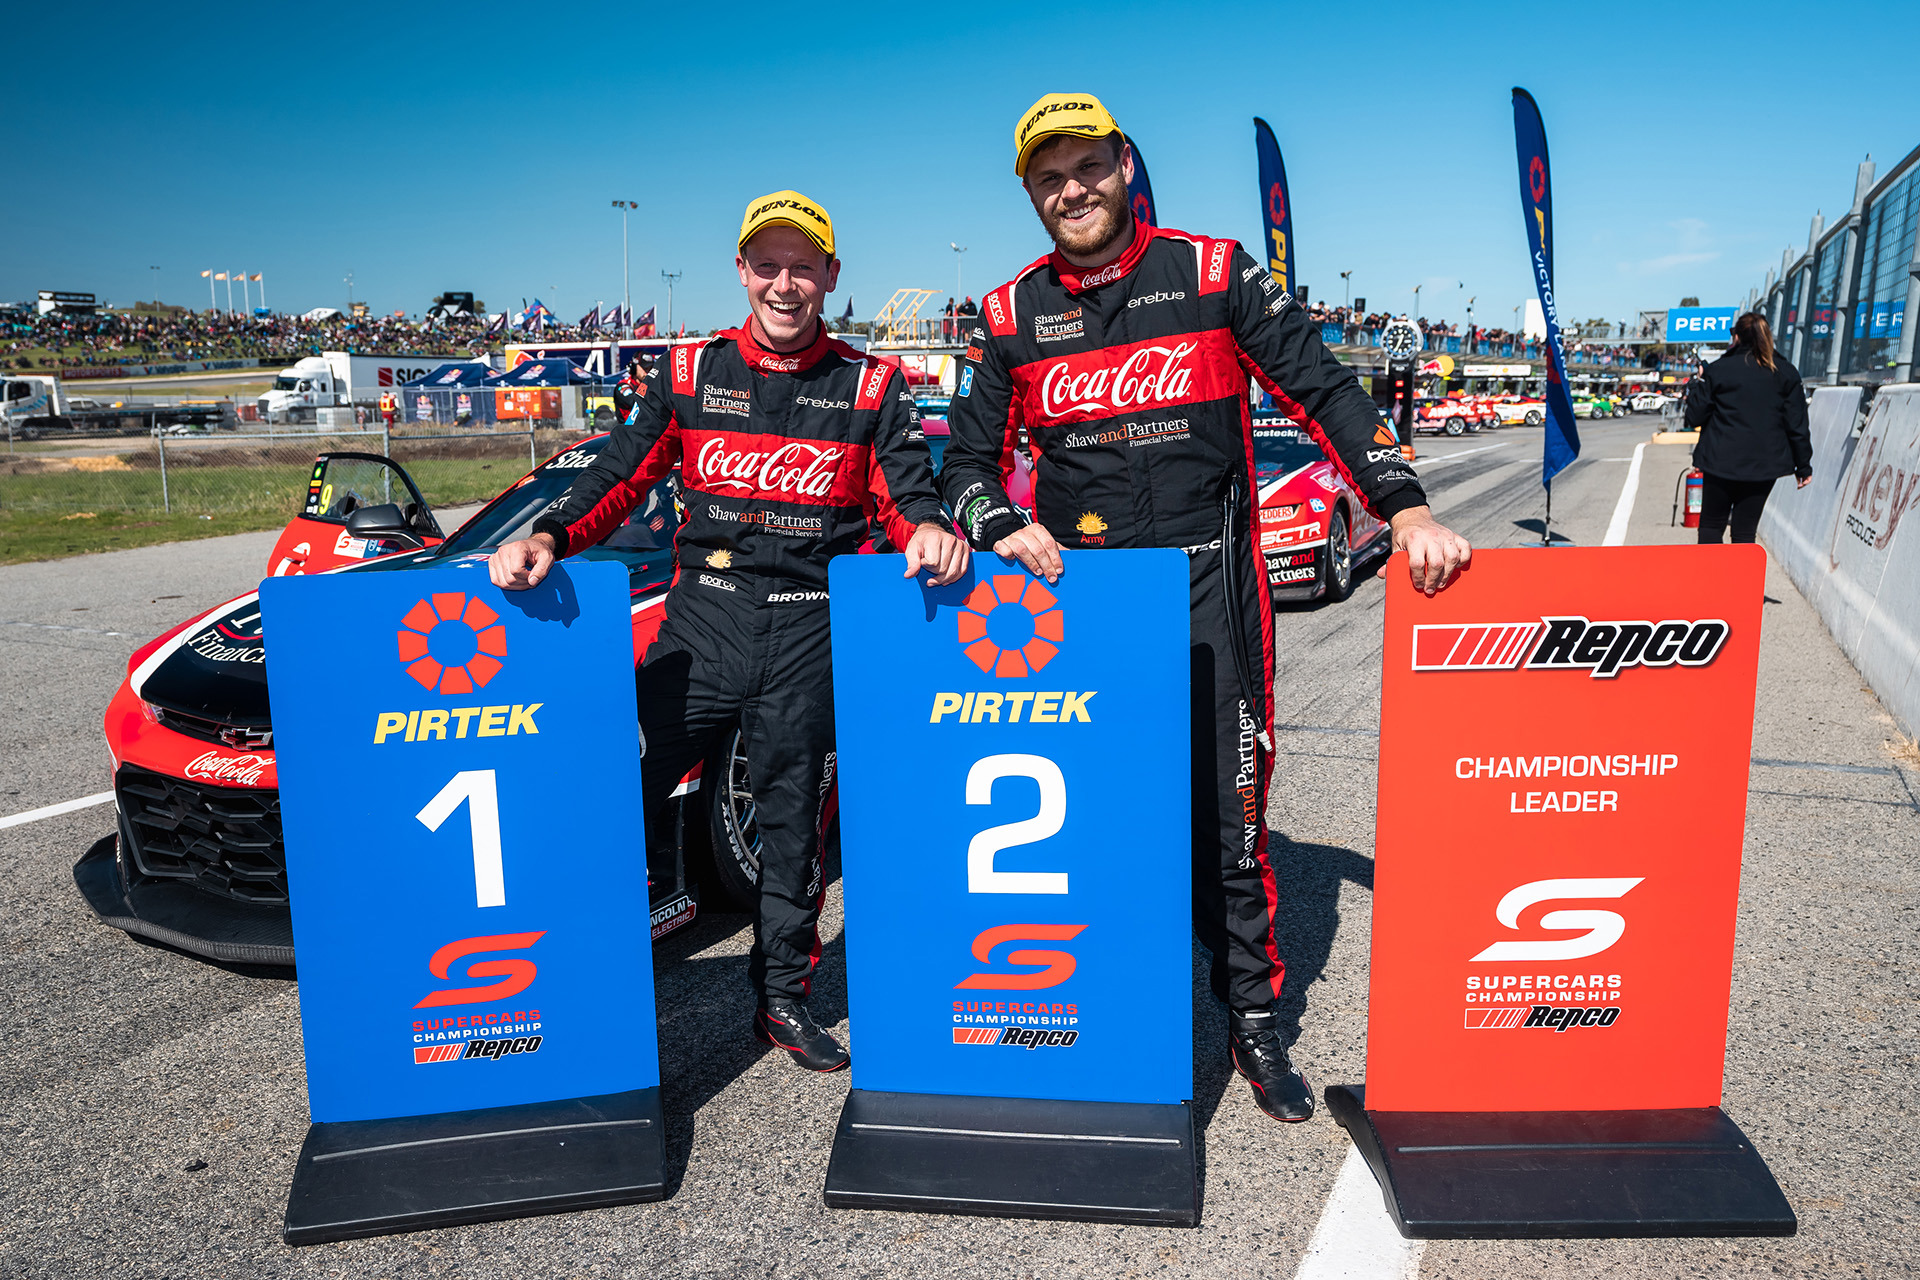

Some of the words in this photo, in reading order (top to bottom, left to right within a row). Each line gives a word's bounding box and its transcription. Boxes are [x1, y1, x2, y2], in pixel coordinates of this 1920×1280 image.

[1020, 102, 1094, 146] DUNLOP
[749, 200, 828, 226] DUNLOP
[1208, 242, 1226, 282] sparco
[1081, 262, 1121, 288] Coca-Cola
[1127, 291, 1185, 308] erebus
[1535, 252, 1560, 330] VICTORY
[989, 292, 1005, 325] sparco
[1035, 320, 1084, 335] Partners
[1675, 316, 1731, 331] PERT
[1036, 335, 1061, 344] Financial
[1062, 331, 1085, 341] Services
[677, 348, 688, 382] sparco
[760, 356, 801, 371] Coca-Cola
[865, 364, 887, 399] sparco
[1042, 340, 1198, 418] Coca-Cola
[702, 394, 750, 410] Partners
[727, 408, 750, 418] Services
[796, 396, 850, 410] erebus
[1427, 405, 1475, 418] AMPOL
[1129, 435, 1161, 448] Financial
[1162, 430, 1191, 443] Services
[697, 437, 845, 497] Coca-Cola
[319, 484, 332, 515] 9
[764, 526, 794, 537] Financial
[795, 528, 823, 538] Services
[1080, 534, 1106, 545] Army
[1260, 521, 1321, 547] SCTR
[699, 573, 736, 591] sparco
[1269, 566, 1315, 584] artners
[1523, 616, 1730, 679] Repco
[930, 691, 1098, 723] PIRTEK
[373, 703, 544, 744] PIRTEK
[184, 751, 276, 786] Coca-Cola
[1455, 754, 1679, 779] CHAMPIONSHIP
[1510, 790, 1619, 813] LEADER
[965, 753, 1069, 895] 2
[415, 769, 506, 908] 1
[650, 900, 686, 928] NCOLN
[651, 911, 691, 938] ELECTRIC
[1466, 974, 1622, 990] SUPERCARS
[952, 1001, 1078, 1015] SUPERCARS
[1465, 991, 1621, 1003] CHAMPIONSHIP
[412, 1009, 542, 1032] SUPERCARS
[952, 1014, 1079, 1026] CHAMPIONSHIP
[1521, 1004, 1622, 1033] Repco
[413, 1022, 542, 1043] CHAMPIONSHIP
[999, 1026, 1080, 1051] Repco
[462, 1035, 543, 1061] Repco
